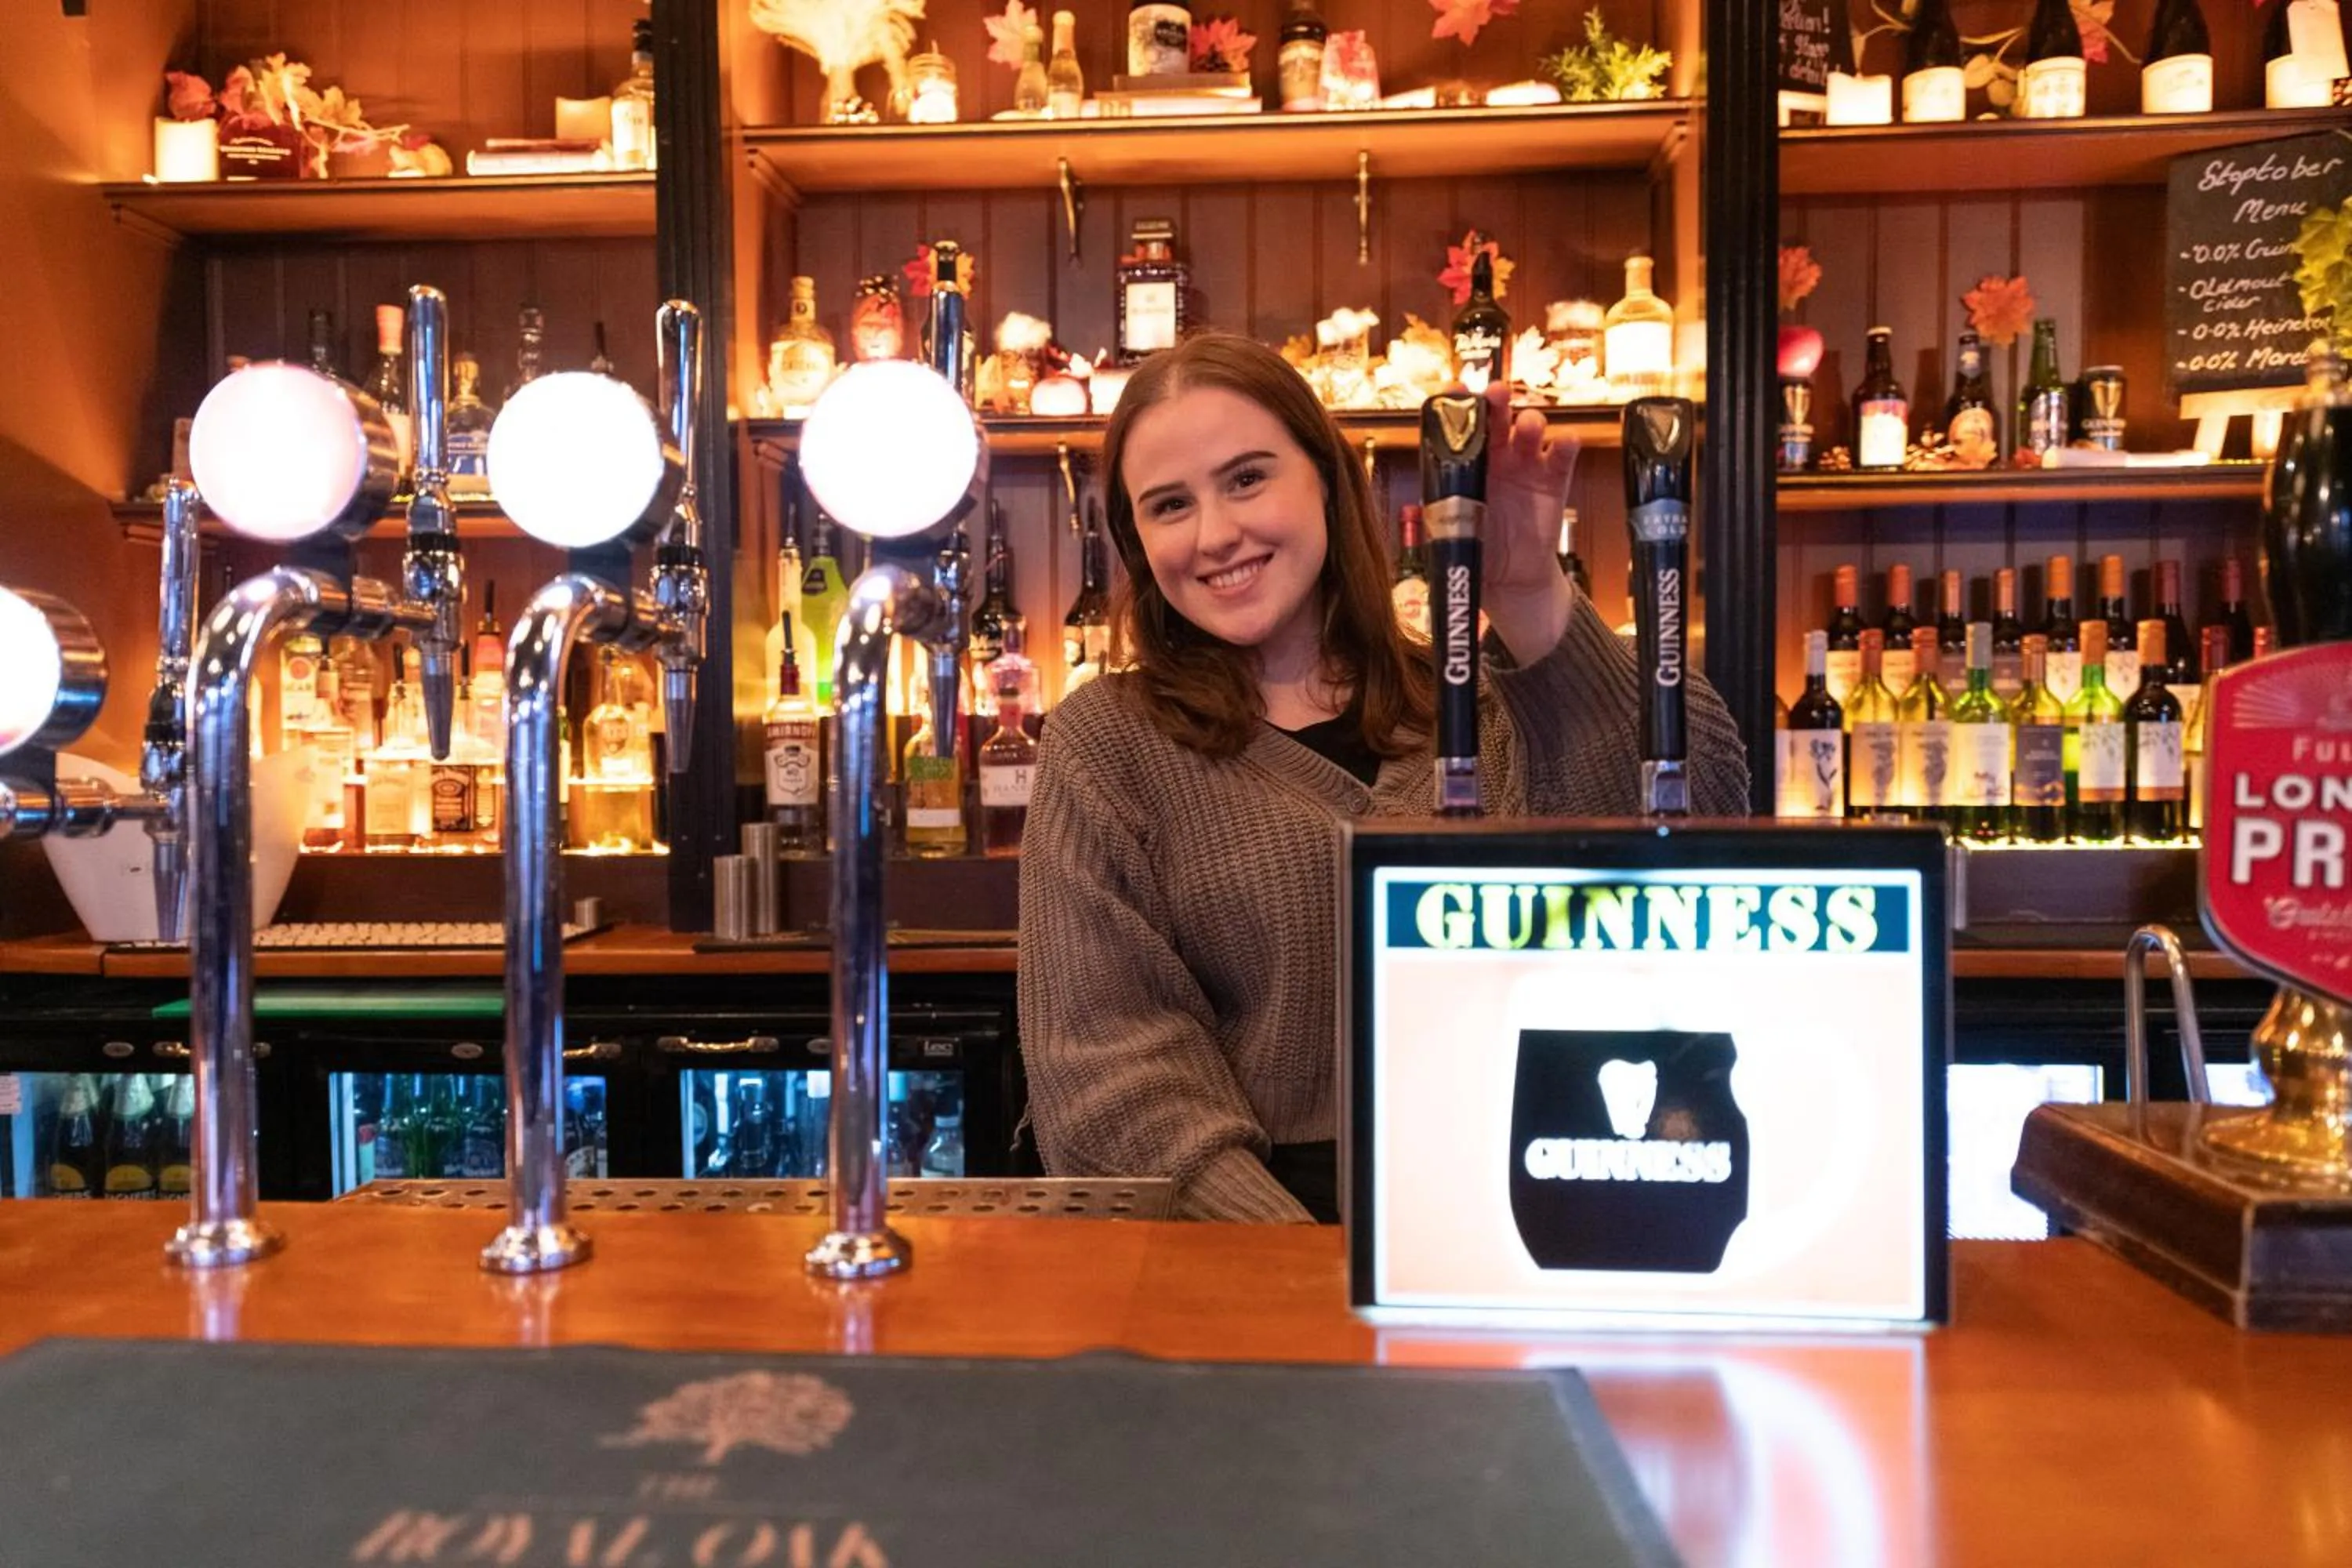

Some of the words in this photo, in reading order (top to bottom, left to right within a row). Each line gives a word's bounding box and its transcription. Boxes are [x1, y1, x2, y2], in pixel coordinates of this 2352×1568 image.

[2198, 153, 2343, 195] Stoptober
[2232, 198, 2307, 223] Menu
[1444, 564, 1471, 686] GUINNESS
[1655, 568, 1682, 688] GUINNESS
[1415, 884, 1878, 952] GUINNESS
[1524, 1138, 1732, 1182] GUINNESS
